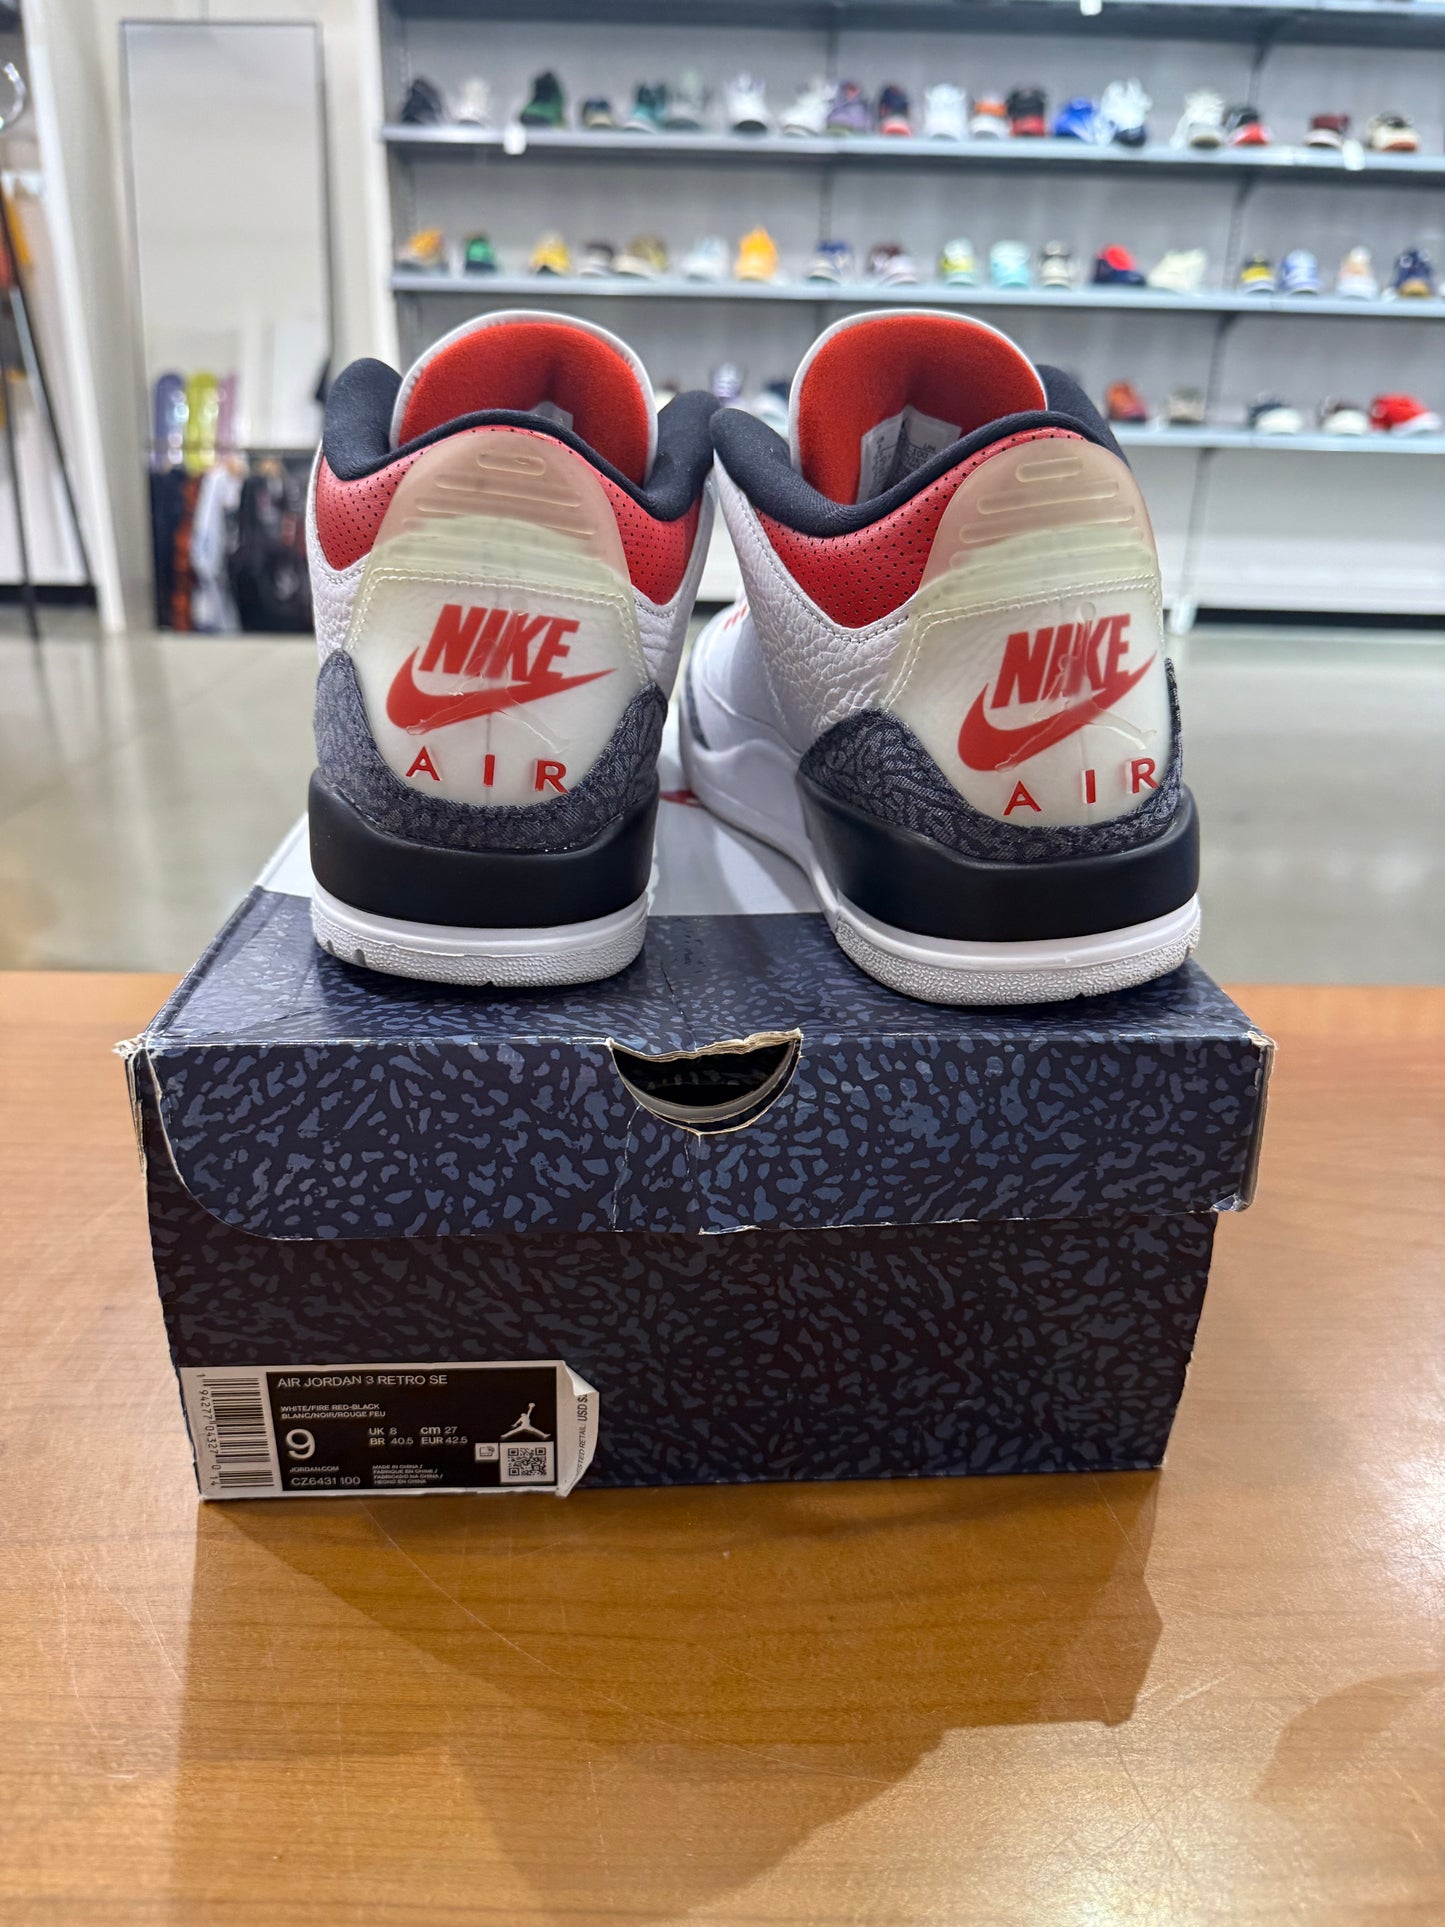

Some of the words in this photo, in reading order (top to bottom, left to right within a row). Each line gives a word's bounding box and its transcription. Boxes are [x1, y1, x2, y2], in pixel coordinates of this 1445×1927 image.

[418, 604, 580, 681] NIKE
[990, 613, 1131, 710] NIKE
[406, 746, 568, 795] AIR
[1003, 757, 1158, 816] AIR
[278, 1378, 300, 1387] AIR
[304, 1376, 361, 1387] JORDAN
[366, 1376, 374, 1385] 3
[378, 1375, 426, 1385] RETRO
[429, 1375, 448, 1385] SE
[281, 1404, 330, 1412] WHITE/FIRE
[332, 1403, 380, 1411] RED-BLACK
[577, 1404, 588, 1421] USD
[282, 1411, 367, 1419] BLANC/NOIR/ROUGE
[369, 1410, 386, 1418] FEU
[369, 1427, 384, 1435] UK
[390, 1427, 397, 1435] 8
[420, 1426, 440, 1434] cm
[444, 1426, 458, 1434] 27
[286, 1428, 316, 1459] 9
[370, 1437, 385, 1445] BR
[390, 1437, 414, 1445] 40.5
[421, 1436, 443, 1444] EUR
[445, 1436, 468, 1444] 42.5
[289, 1465, 340, 1473] JORDAN.COM
[291, 1477, 336, 1486] CZ6431
[340, 1476, 361, 1485] 100
